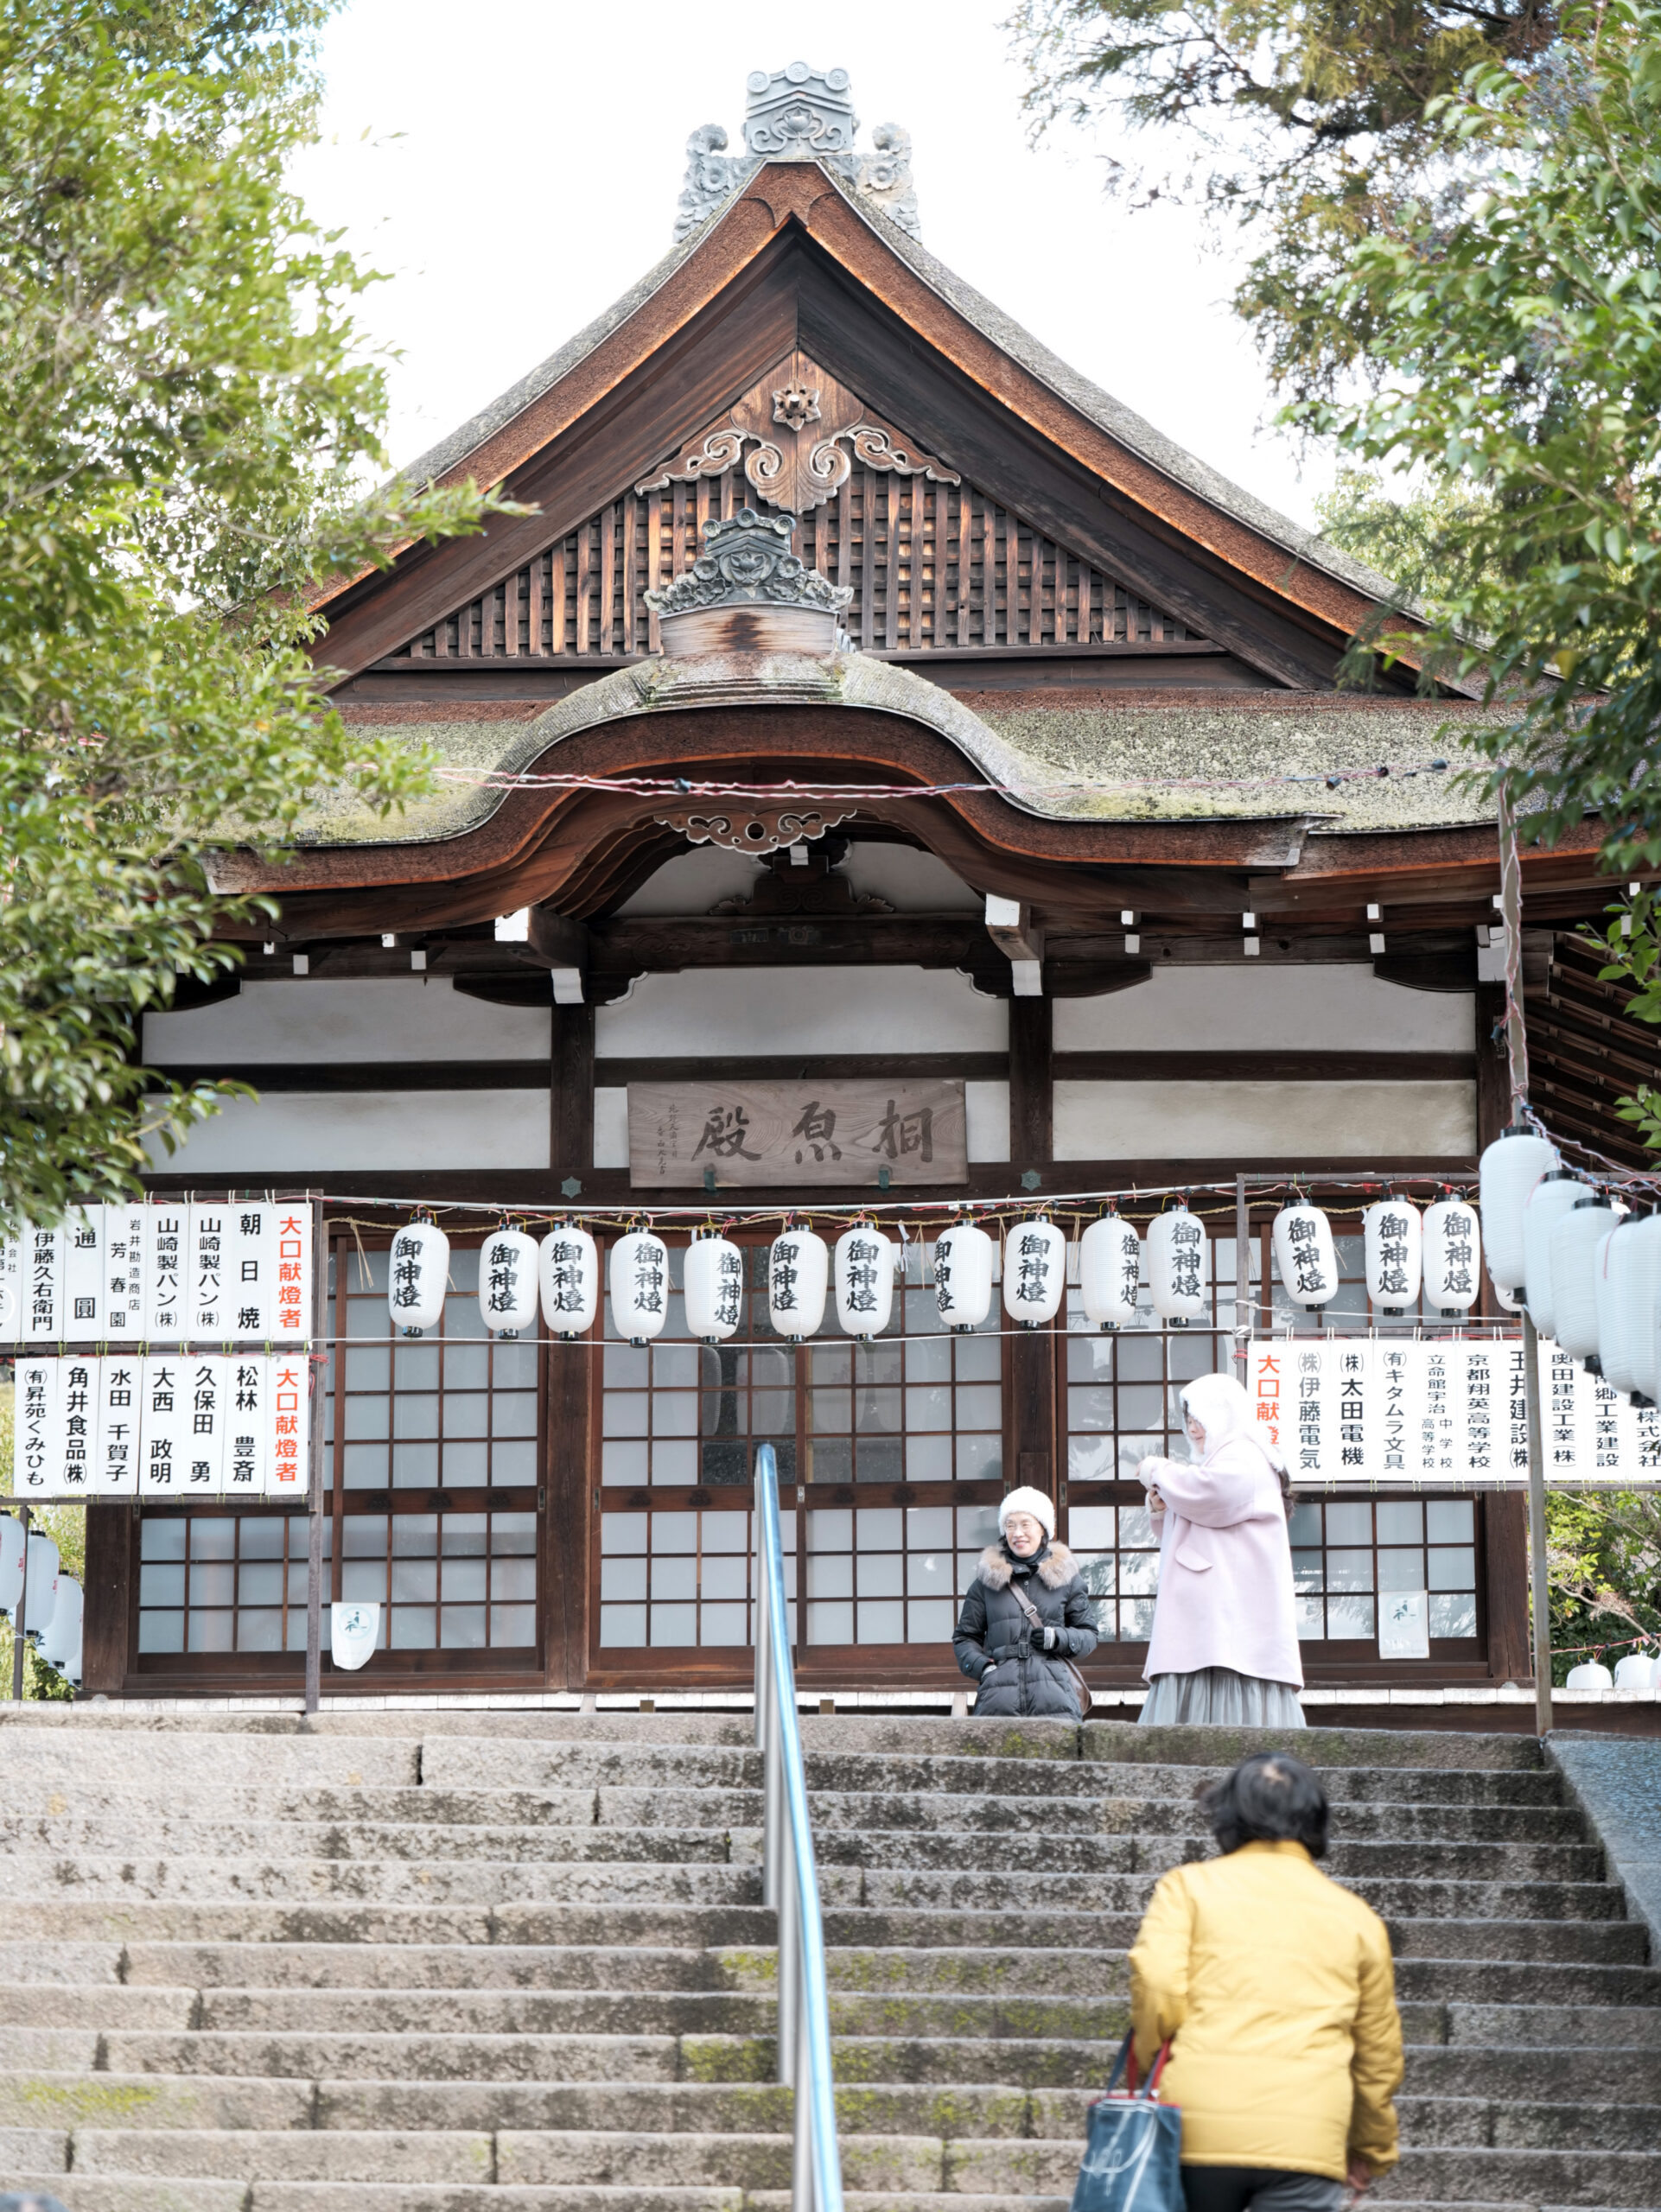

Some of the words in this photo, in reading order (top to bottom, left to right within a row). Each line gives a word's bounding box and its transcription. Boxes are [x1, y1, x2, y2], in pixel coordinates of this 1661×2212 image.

[33, 1224, 55, 1332] 伊藤久右衛門
[110, 1242, 127, 1328] 芳春園
[129, 1219, 141, 1311] 岩井勘造商店
[238, 1213, 261, 1329] 朝日焼
[278, 1216, 302, 1328] 大口献燈者
[393, 1236, 423, 1307] 御神燈
[488, 1243, 519, 1313] 御神燈
[551, 1241, 583, 1313] 御神燈
[633, 1242, 664, 1313] 御神燈
[715, 1251, 741, 1326] 御神燈
[772, 1240, 799, 1312] 御神燈
[845, 1239, 880, 1312] 御神燈
[1015, 1234, 1051, 1303] 御神燈
[1171, 1222, 1201, 1297] 御神燈
[1287, 1217, 1327, 1294] 御神燈
[1378, 1212, 1409, 1294] 御神燈
[1442, 1211, 1473, 1294] 御神燈
[1427, 1354, 1447, 1414] 立命館宇治
[1466, 1354, 1492, 1469] 京都翔英高等学校
[275, 1368, 299, 1482] 大口献燈者
[1422, 1418, 1435, 1469] 高等学校
[1439, 1418, 1453, 1469] 中学校
